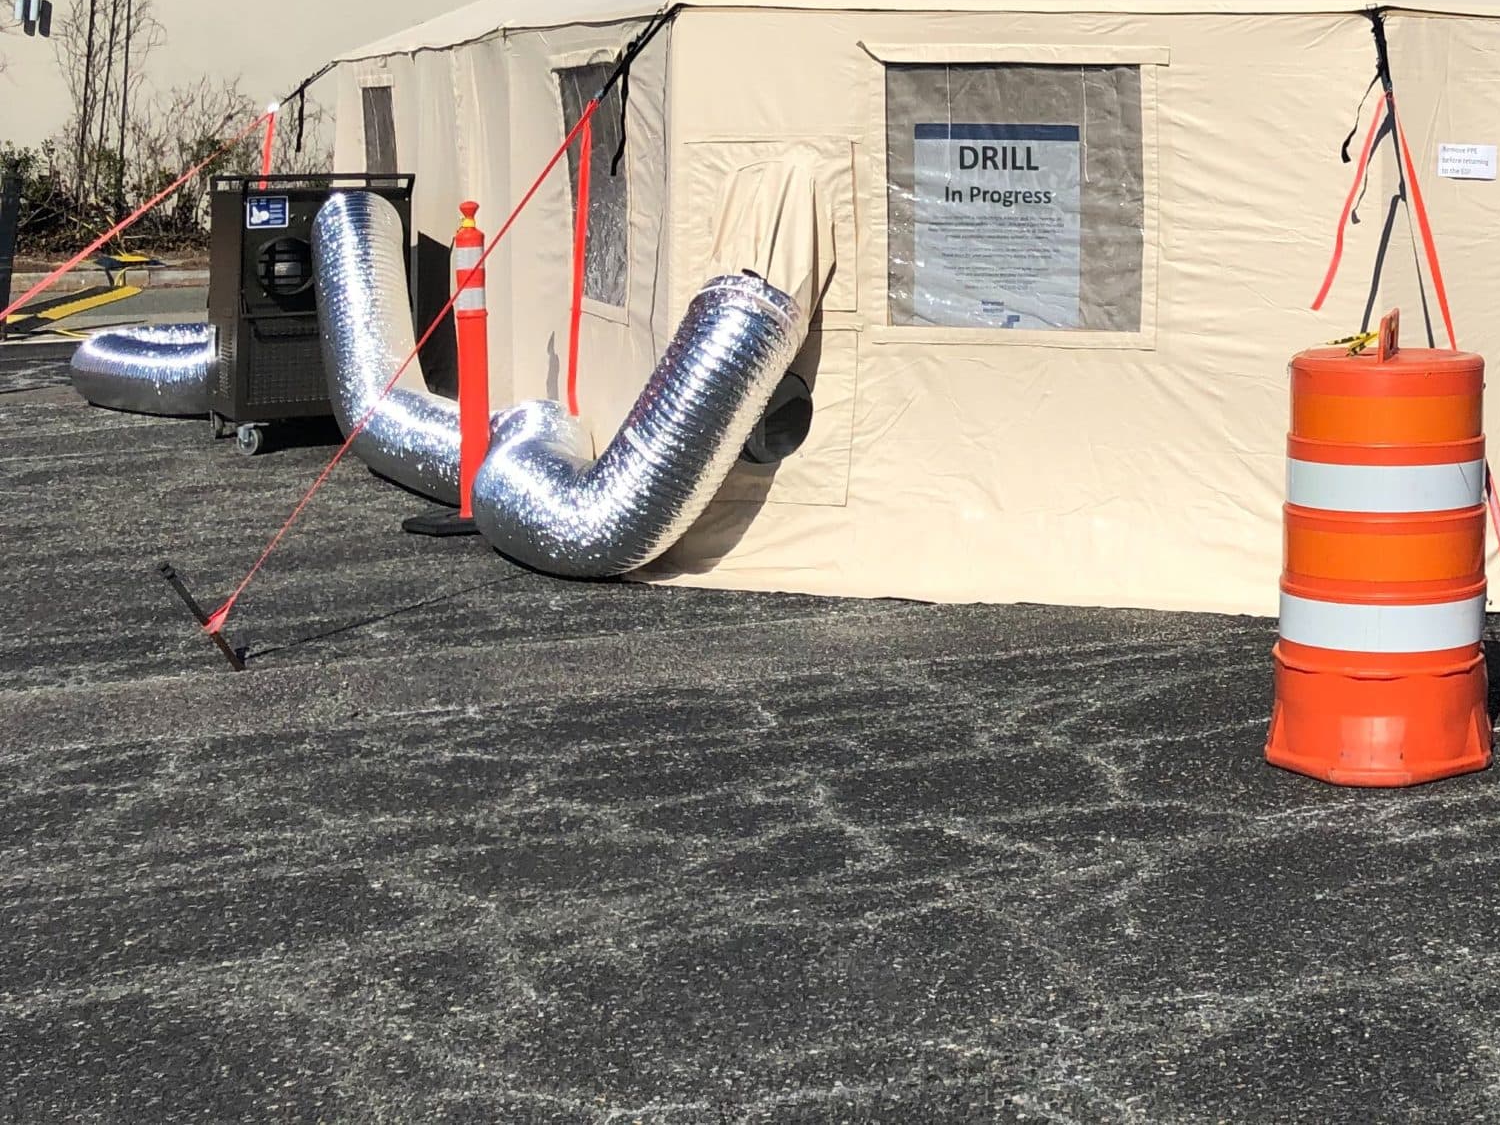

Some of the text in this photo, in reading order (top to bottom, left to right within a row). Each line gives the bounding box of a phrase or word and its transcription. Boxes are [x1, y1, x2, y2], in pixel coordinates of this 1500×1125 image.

[959, 145, 1039, 171] DRILL
[945, 186, 1052, 208] In Progress
